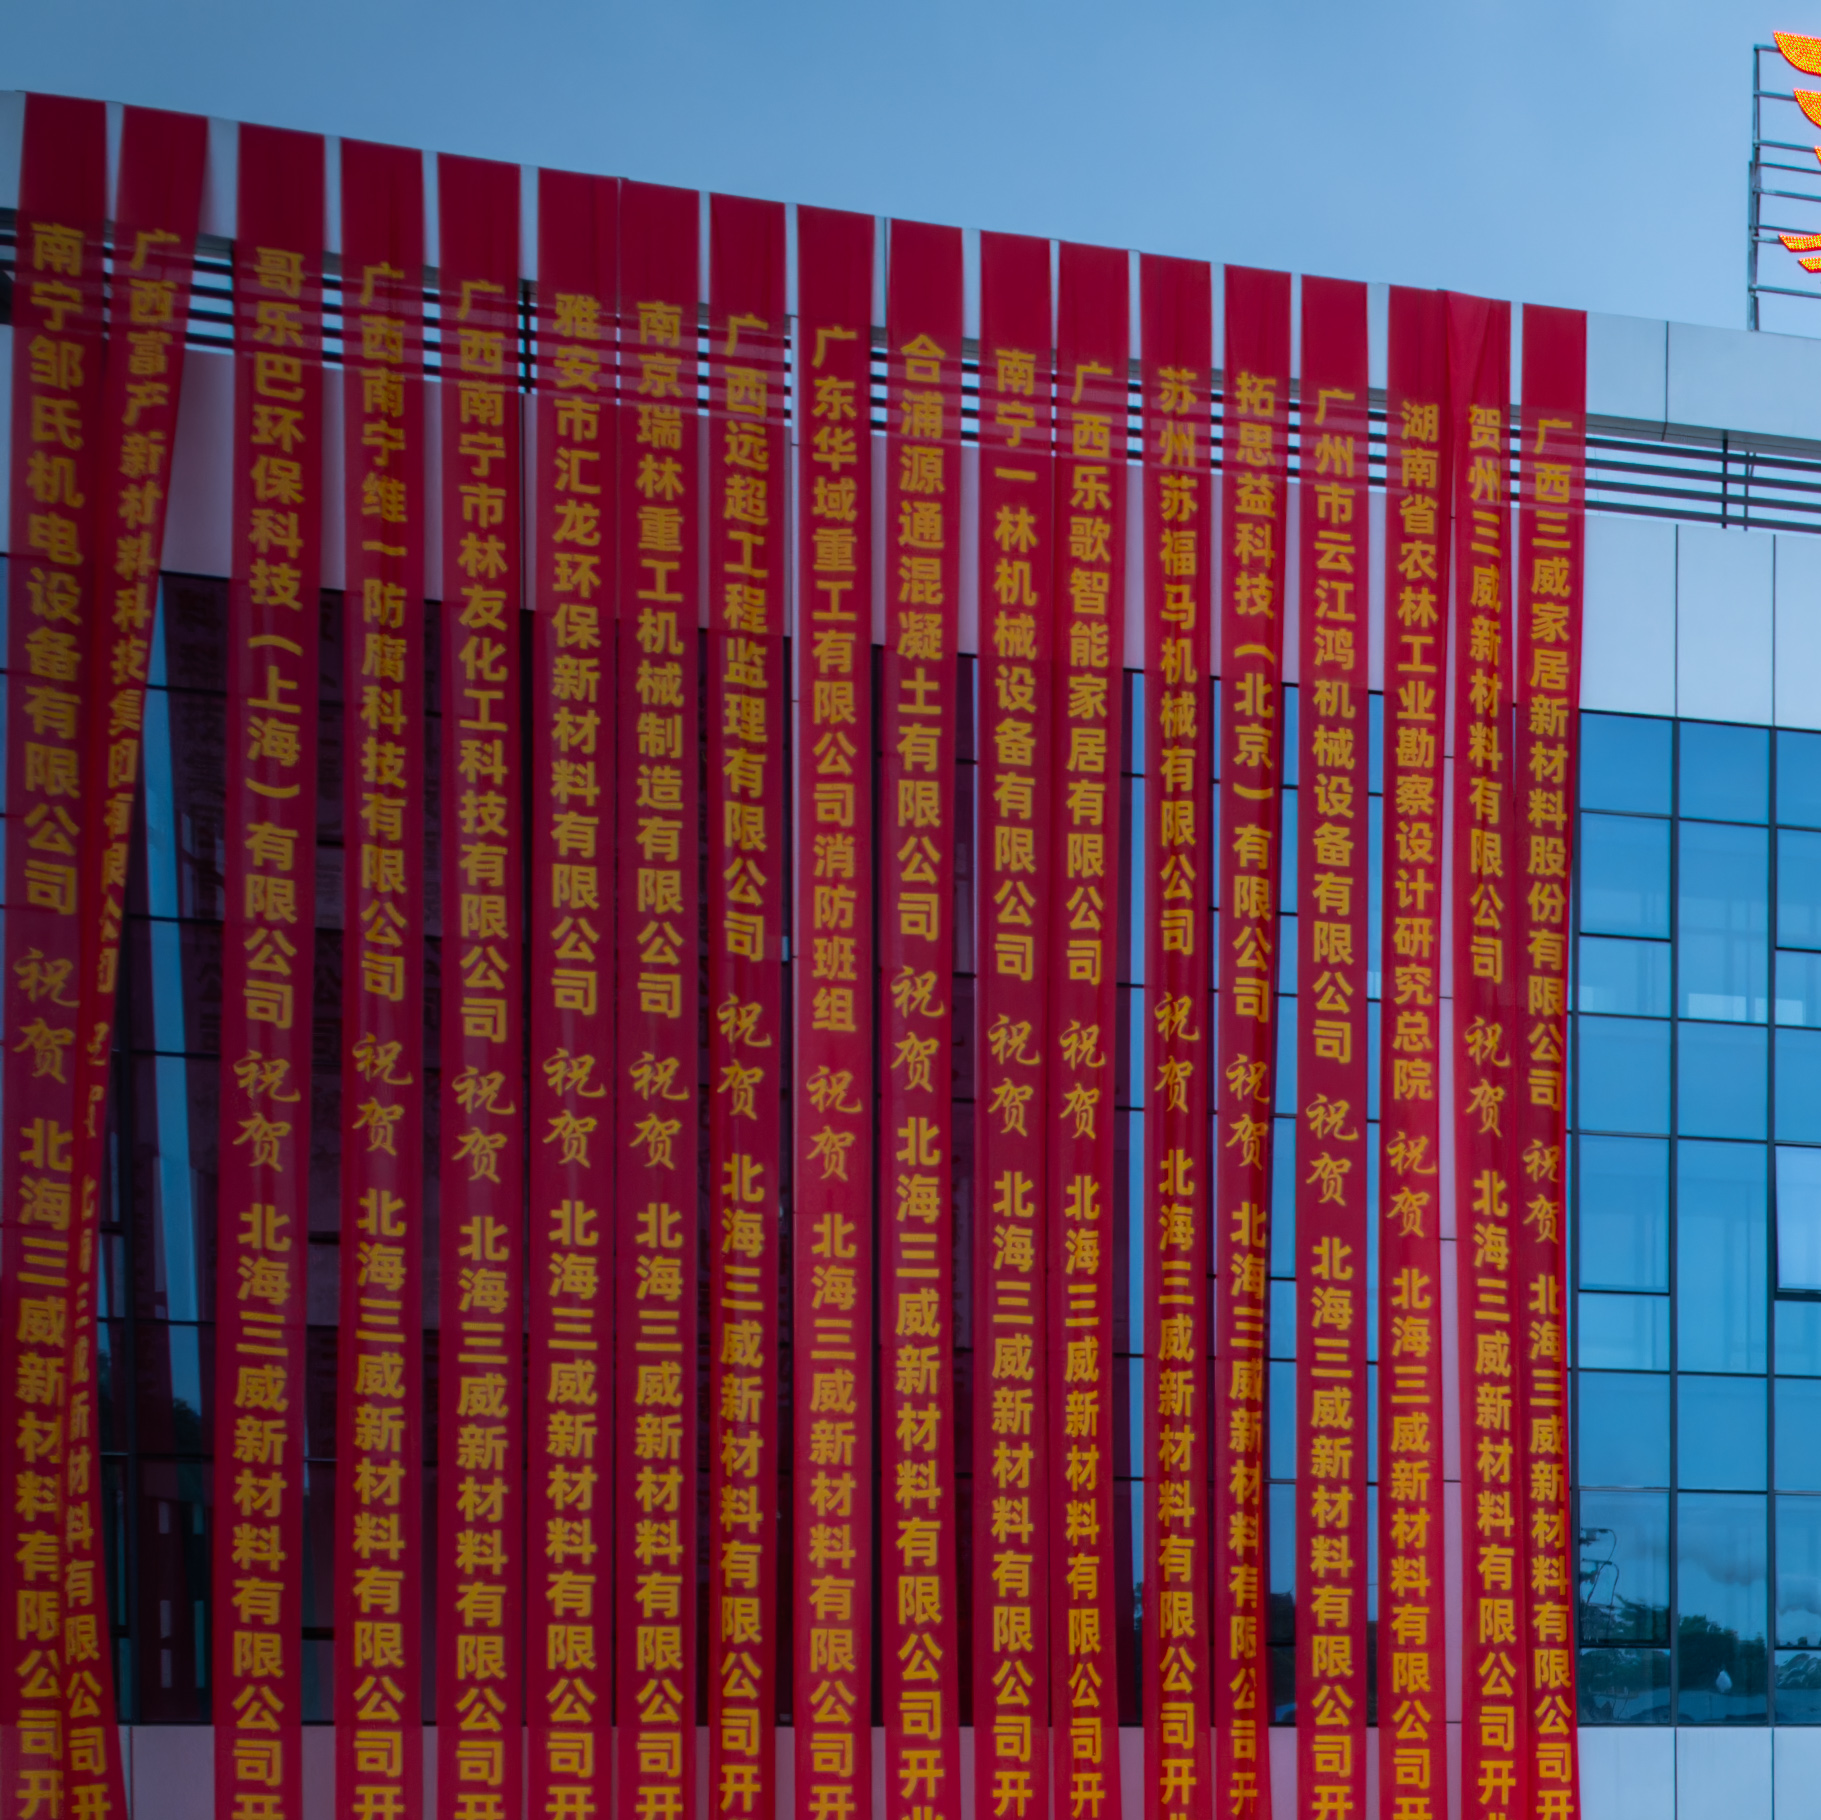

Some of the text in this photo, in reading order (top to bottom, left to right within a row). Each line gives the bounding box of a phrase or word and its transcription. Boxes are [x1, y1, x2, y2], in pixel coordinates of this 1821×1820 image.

[22, 222, 85, 915] 南宁邹氏机电设备有限公司
[360, 262, 408, 1001] 广西南宁维一防腐科技有限公司
[457, 280, 509, 1043] 广西南宁市林友化工科技有限公司
[550, 294, 602, 1016] 雅安市汇龙环保新材料有限公司
[635, 301, 685, 1019] 南京瑞林重工机械制造有限公司
[722, 313, 770, 962] 广西远超工程监理有限公司
[811, 325, 858, 1032] 广东华域重工有限公司消防班组
[896, 334, 946, 941] 合浦源通混凝土有限公司
[992, 349, 1039, 982] 南宁一林机械设备有限公司
[1065, 361, 1113, 986] 广西乐歌智能家居有限公司
[1158, 367, 1199, 956] 苏州苏福马机械有限公司
[1467, 404, 1504, 984] 贺州三威新材料有限公司
[1311, 388, 1357, 1064] 广州市云江鸿机械设备有限公司
[1392, 400, 1440, 1100] 湖南省农林工业勘察设计研究总院
[1526, 418, 1573, 1111] 广西三威家居新材料股份有限公司
[16, 950, 74, 1081] 祝贺
[715, 995, 772, 1120] 祝贺
[890, 965, 946, 1092] 祝贺
[986, 1014, 1042, 1136] 祝贺
[1058, 1020, 1107, 1139] 祝贺
[1153, 992, 1201, 1113] 祝贺
[1463, 1016, 1512, 1136] 祝贺
[233, 1051, 301, 1171] 祝贺
[351, 1034, 414, 1155] 祝贺
[451, 1066, 516, 1182] 祝贺
[542, 1048, 607, 1167] 祝贺
[628, 1052, 690, 1169] 祝贺
[805, 1066, 863, 1180] 祝贺
[1224, 1054, 1271, 1168] 祝贺
[1304, 1094, 1360, 1206] 祝贺
[1385, 1131, 1438, 1238] 祝贺
[1505, 1139, 1560, 1243] 祝贺
